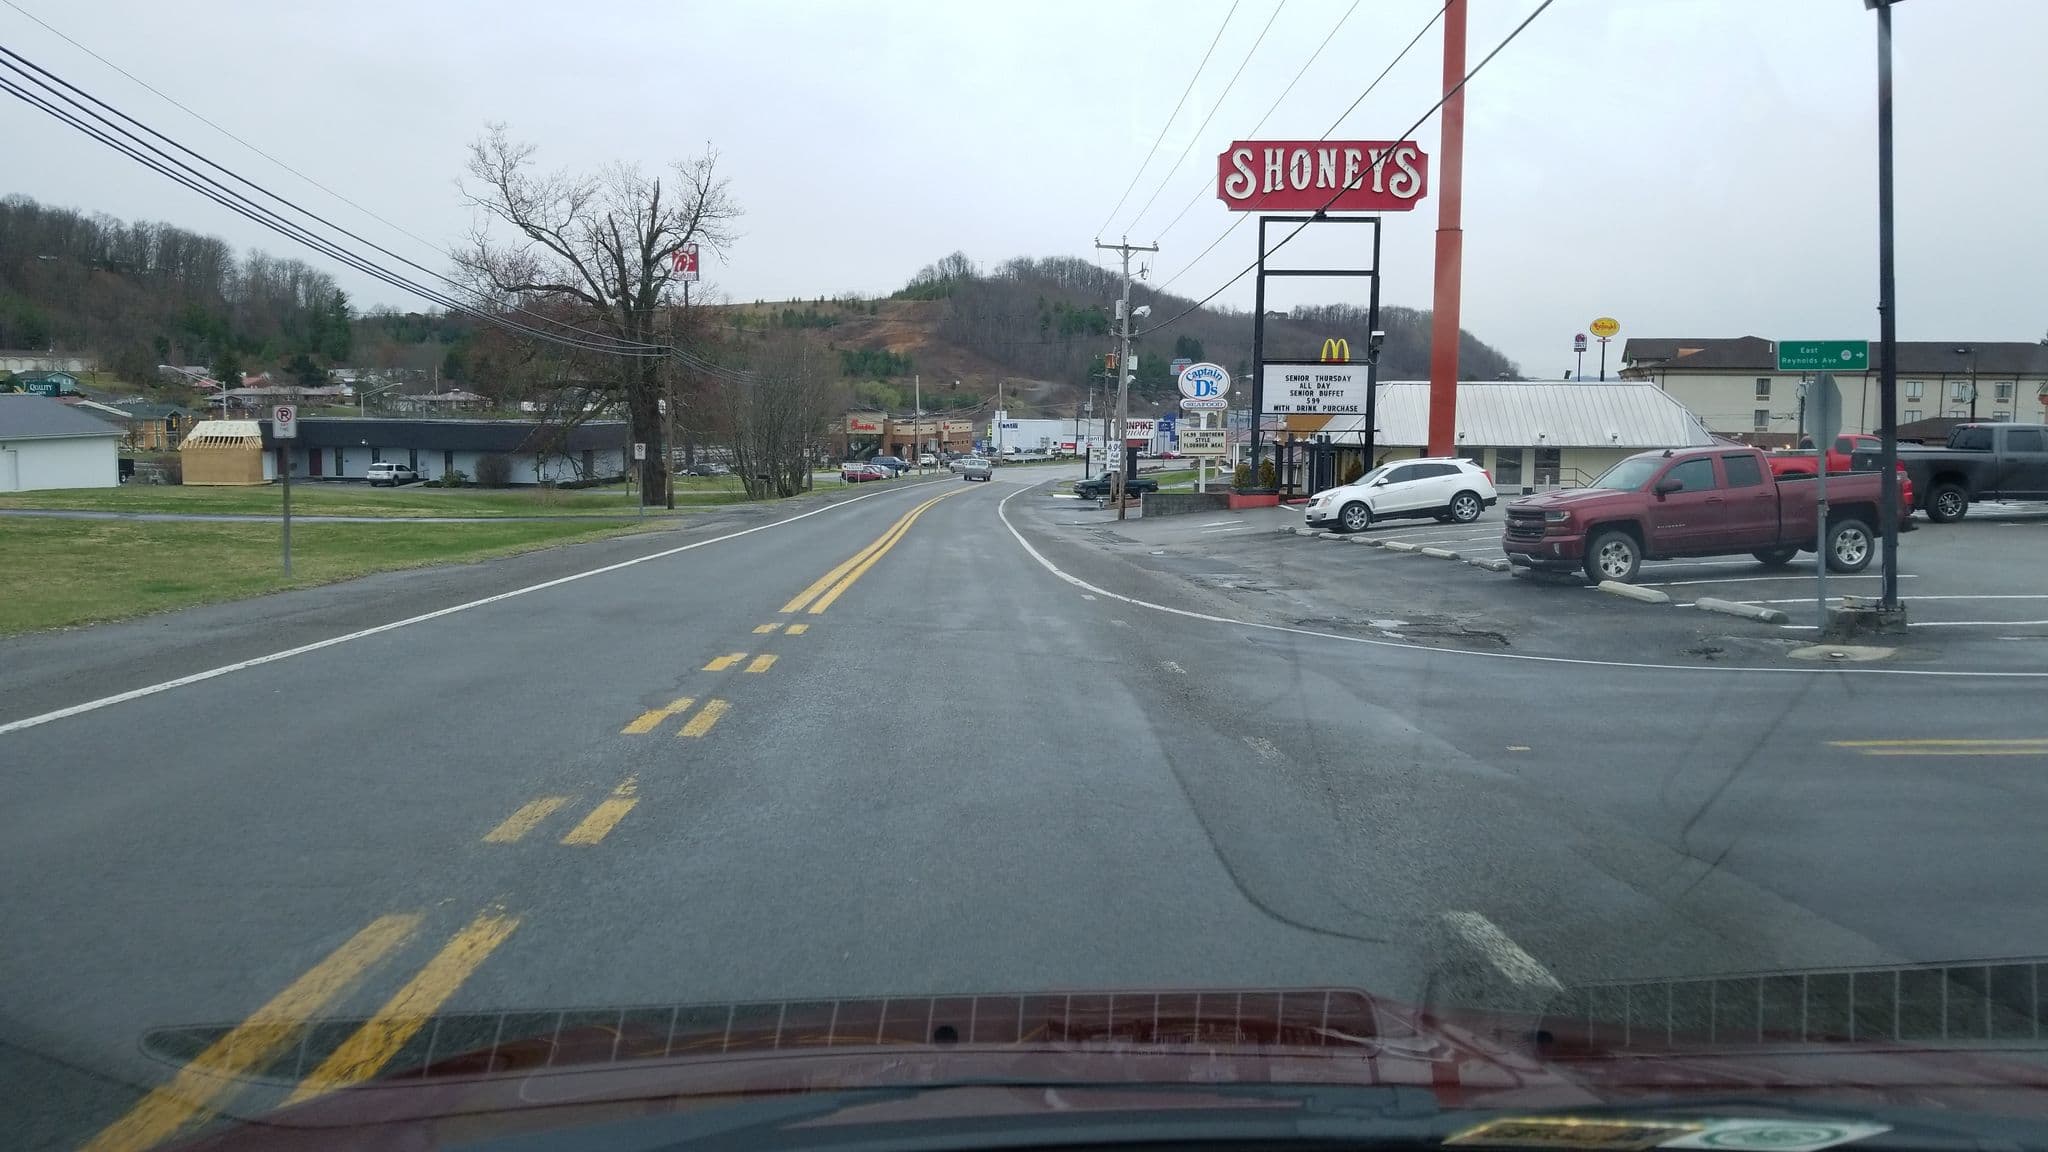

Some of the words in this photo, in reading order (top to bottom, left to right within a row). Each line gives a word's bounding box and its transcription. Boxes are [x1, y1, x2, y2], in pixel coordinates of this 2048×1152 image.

[1224, 147, 1421, 199] SHONEY'S
[1781, 357, 1818, 365] Reynolds
[1186, 367, 1223, 382] Captain
[1194, 379, 1218, 397] D's
